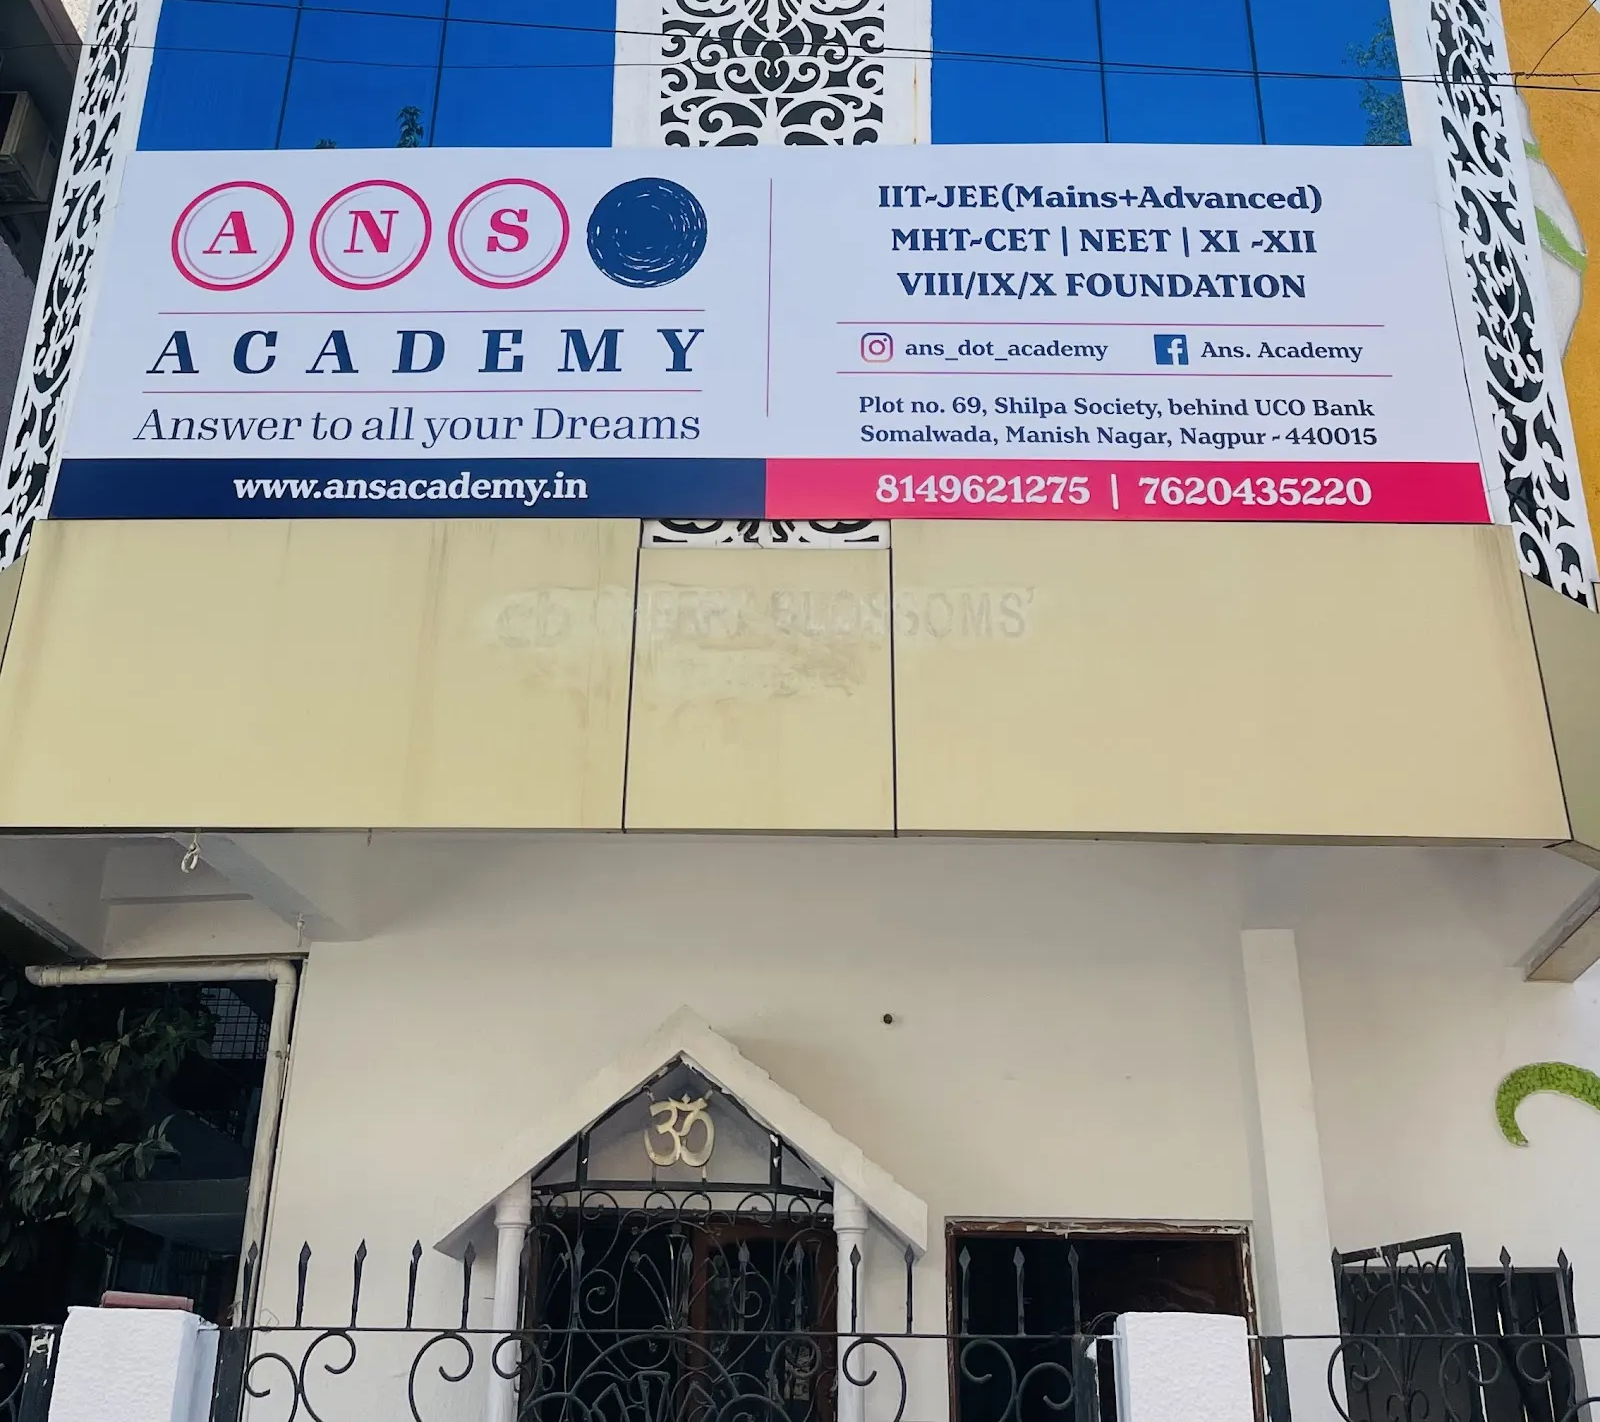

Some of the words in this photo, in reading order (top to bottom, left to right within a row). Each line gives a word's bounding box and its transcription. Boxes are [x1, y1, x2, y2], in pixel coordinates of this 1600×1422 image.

[877, 182, 1323, 215] IIT-JEE(Mains+Advanced)
[891, 227, 1051, 253] MHT-CET
[1078, 228, 1172, 254] NEET
[896, 270, 1058, 300] VIII/IX/X
[1065, 272, 1306, 300] FOUNDATION
[145, 328, 705, 375] ACADEMY
[905, 339, 1109, 363] ans_dot_academy
[1200, 341, 1252, 360] Ans.
[1257, 341, 1364, 365] Academy
[859, 395, 905, 415] Plot
[910, 400, 946, 415] no.
[952, 396, 988, 418] 69,
[994, 396, 1068, 419] Shilpa
[1074, 397, 1163, 421] Society,
[1167, 397, 1250, 417] behind
[1254, 398, 1306, 417] UCO
[1311, 399, 1376, 417] Bank
[132, 407, 303, 442] Answer
[311, 411, 353, 442] to
[361, 406, 415, 442] all
[421, 416, 525, 450] your
[531, 407, 701, 442] Dreams
[860, 424, 999, 447] Somalwada,
[1005, 425, 1091, 445] Manish
[1096, 426, 1173, 449] Nagar,
[1178, 427, 1267, 450] Nagpur
[233, 470, 589, 508] www.ansacademy.in
[875, 474, 1091, 506] 8149621275
[1137, 475, 1373, 507] 7620435220
